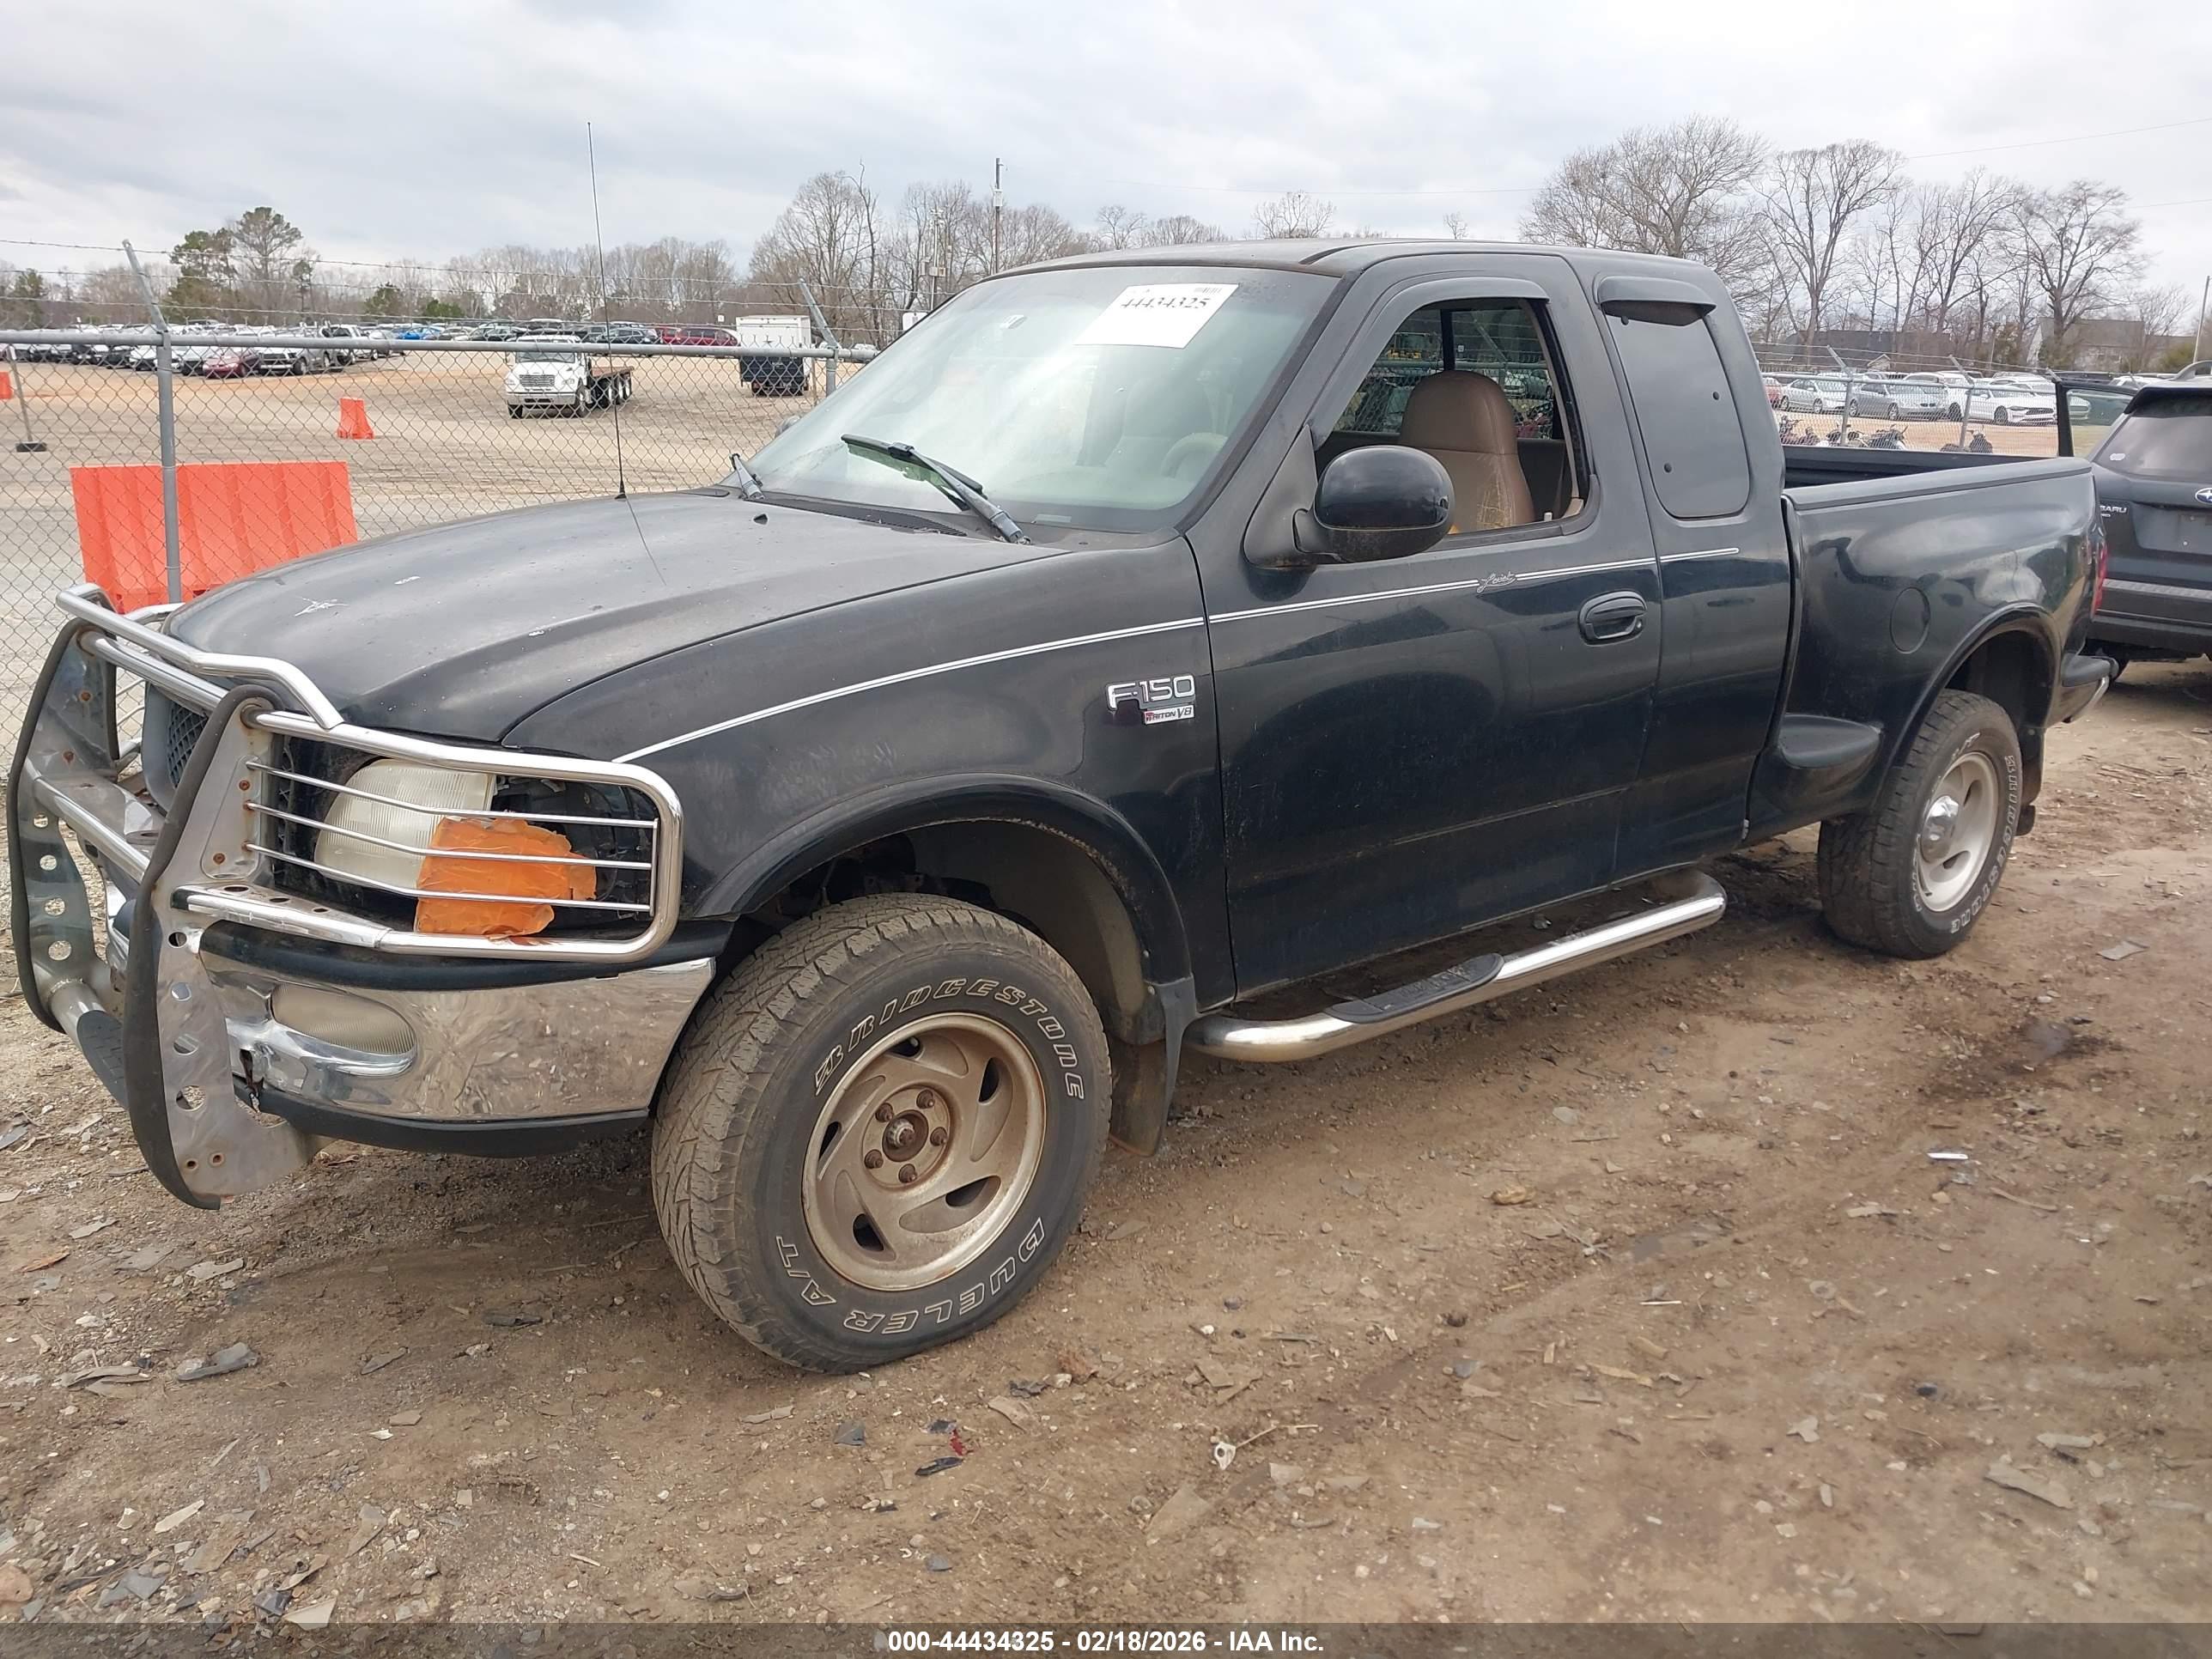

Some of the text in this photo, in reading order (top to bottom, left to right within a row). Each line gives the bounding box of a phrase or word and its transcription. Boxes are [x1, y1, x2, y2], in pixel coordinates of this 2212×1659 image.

[1121, 296, 1212, 309] 44434325
[2100, 505, 2127, 514] BARU
[1144, 707, 1193, 722] TRITON V8
[814, 978, 1085, 1100] BRIDGESTONE
[775, 1217, 1045, 1334] DUELER A/T
